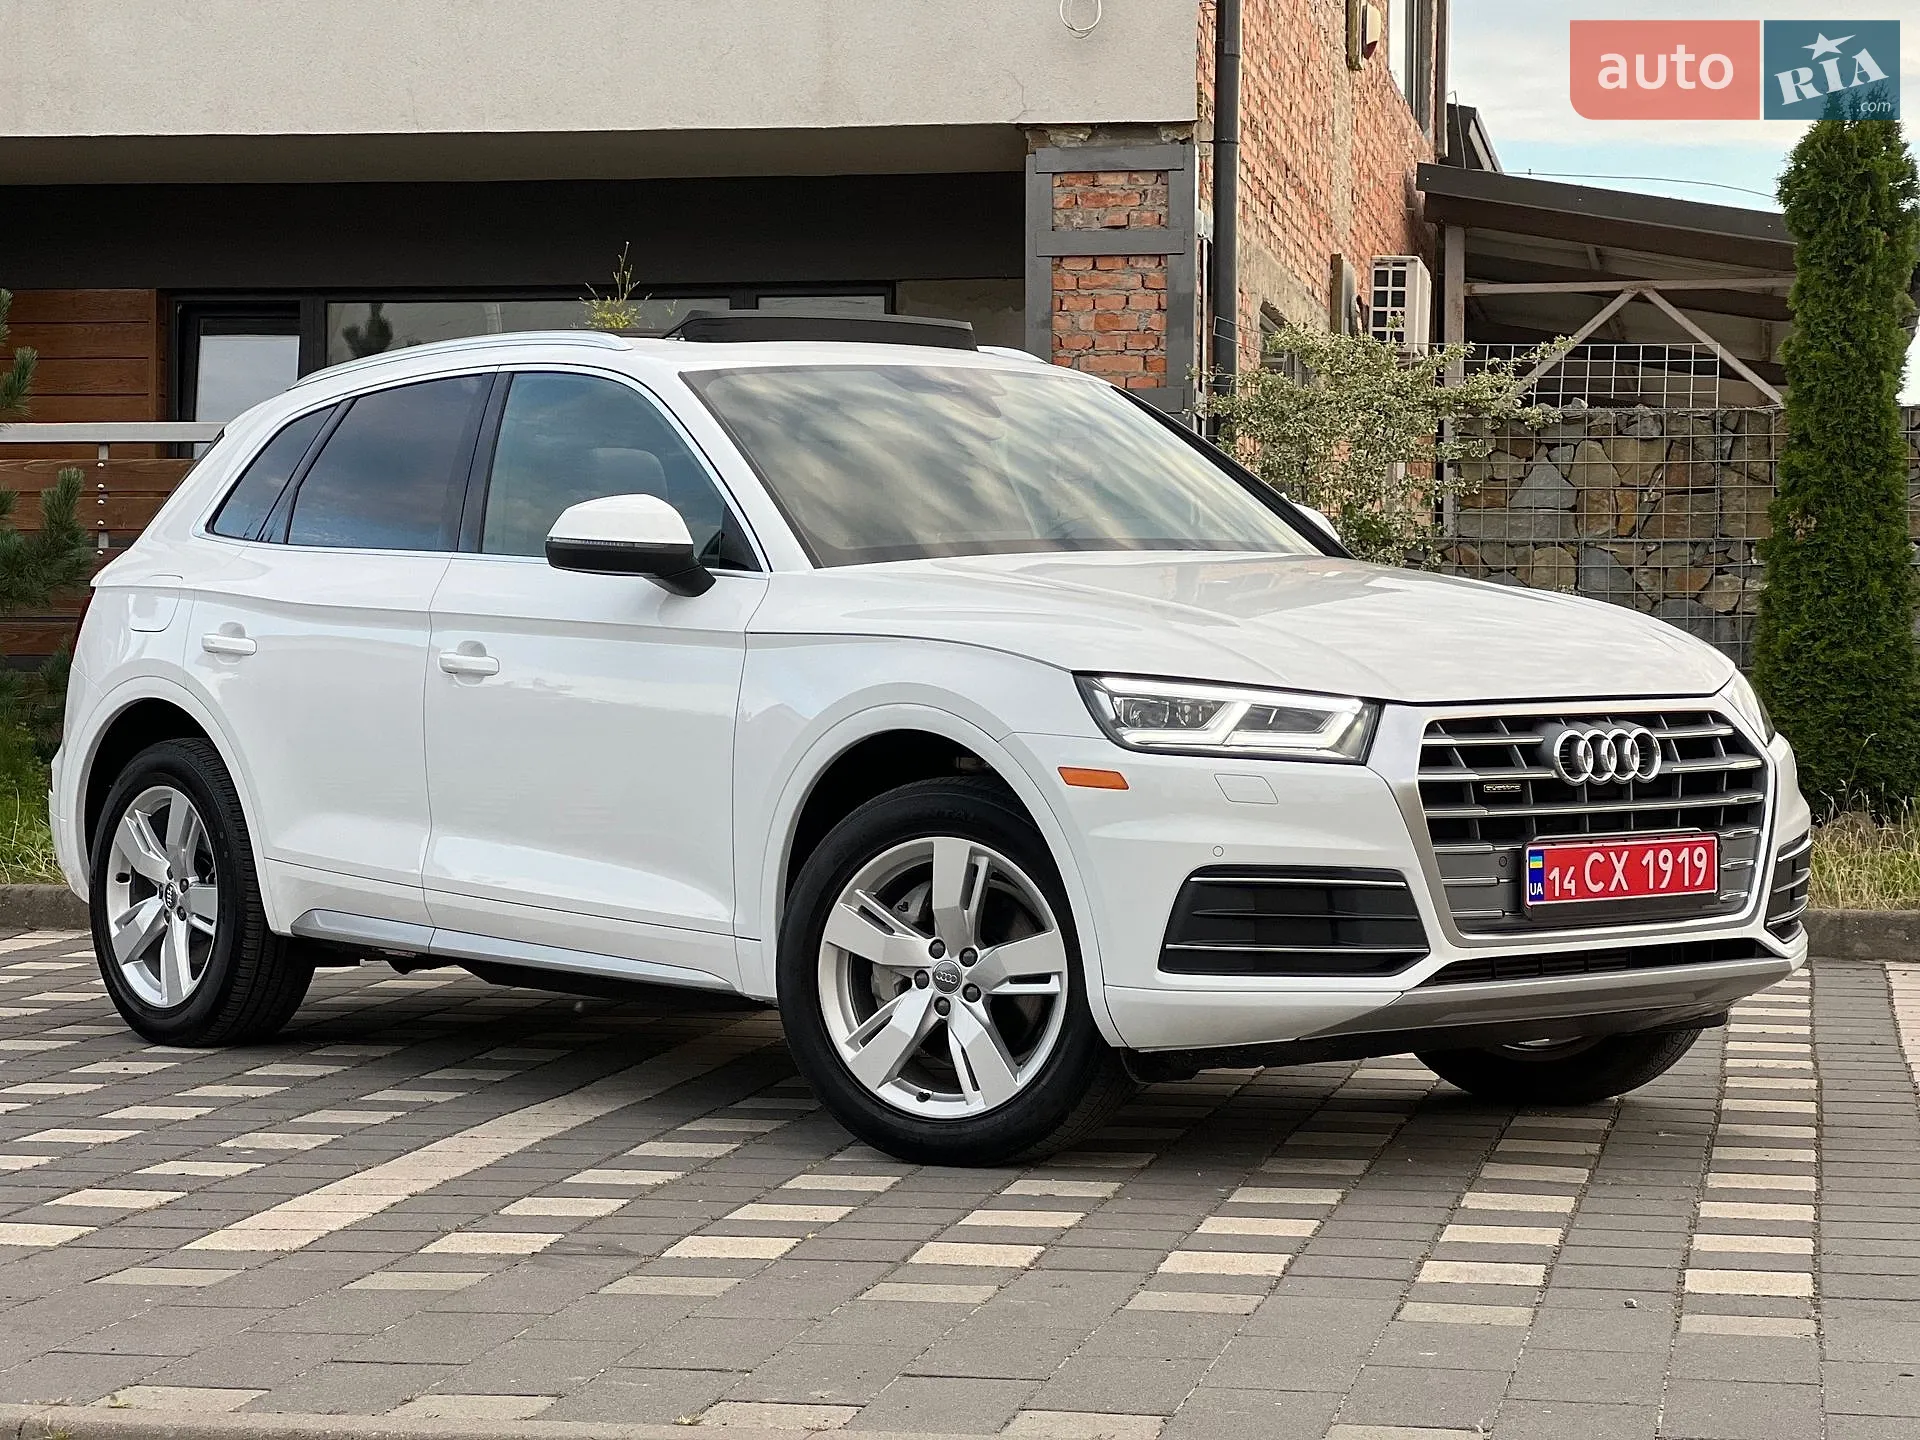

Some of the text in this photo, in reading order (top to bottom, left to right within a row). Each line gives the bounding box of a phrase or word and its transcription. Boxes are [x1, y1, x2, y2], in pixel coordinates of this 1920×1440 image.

[1549, 847, 1708, 897] 14 CX 1919
[1530, 883, 1543, 896] UA
